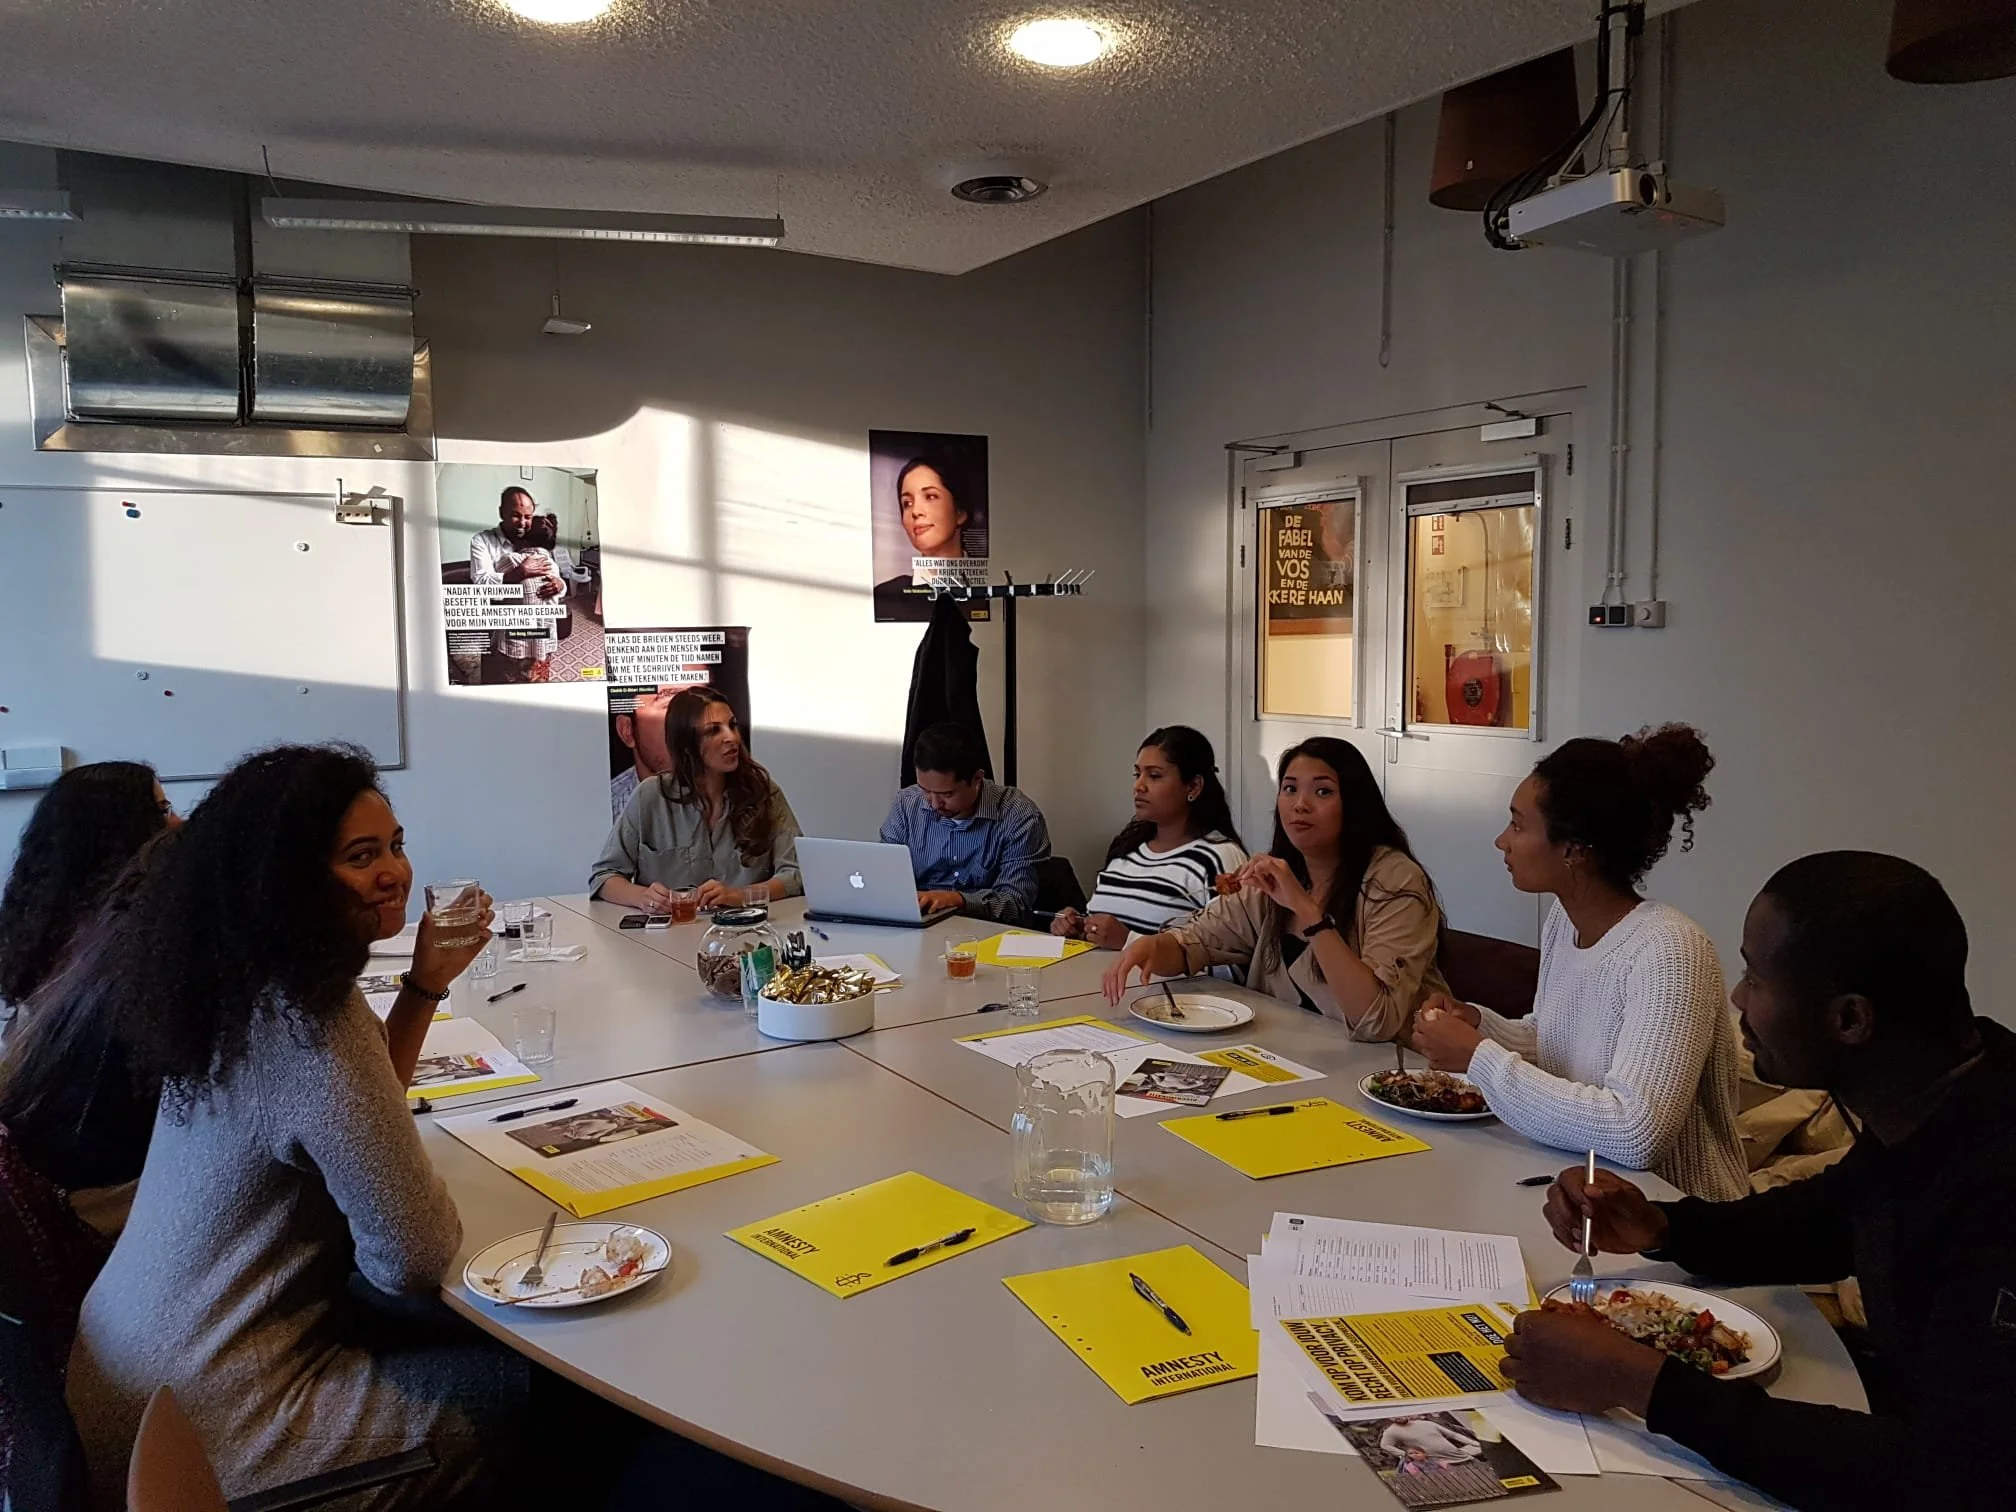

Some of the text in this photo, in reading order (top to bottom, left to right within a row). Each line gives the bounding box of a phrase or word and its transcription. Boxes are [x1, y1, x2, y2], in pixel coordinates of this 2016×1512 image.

[1285, 515, 1302, 528] DE
[1279, 529, 1313, 547] FABEL
[1278, 549, 1313, 559] VAN DE
[1276, 559, 1310, 579] VOS
[1280, 579, 1309, 590] EN DE
[473, 587, 481, 596] IK
[482, 586, 521, 596] VRIJKWAM
[445, 597, 488, 607] BESEFTE IK
[1309, 590, 1344, 605] HAAN
[445, 607, 564, 617] HOEVEEL AMNESTY HAD GEDAAN
[446, 619, 467, 627] VOOR
[468, 618, 487, 627] MIJN
[617, 636, 630, 644] LAS
[643, 635, 674, 643] BRIEVEN
[675, 635, 700, 643] STEEDS
[607, 645, 640, 654] DENKEND
[657, 645, 669, 653] DIE
[670, 644, 699, 652] MENSEN
[608, 655, 620, 664] DIE
[620, 655, 636, 664] VIJF
[637, 654, 669, 663] MINUTEN
[670, 654, 679, 662] DE
[696, 653, 720, 661] NAMEN
[608, 664, 681, 674] OM ME TE SCHRIJVEN
[619, 675, 634, 683] EEN
[635, 674, 669, 683] TEKENING
[671, 673, 679, 682] TE
[750, 1233, 801, 1260] INTERNATIONAL
[762, 1228, 820, 1254] AMNESTY
[1284, 1321, 1321, 1343] JOUW
[1475, 1323, 1492, 1334] HET
[1311, 1321, 1357, 1358] PRIVACY.
[1485, 1333, 1505, 1343] DOE
[1306, 1344, 1339, 1368] VOOR
[1141, 1351, 1224, 1378] AMNESTY
[1343, 1359, 1368, 1371] OP
[1151, 1362, 1237, 1386] INTERNATIONAL
[1326, 1368, 1351, 1381] OP
[1337, 1382, 1371, 1401] KOM
[1354, 1372, 1396, 1399] RECHT
